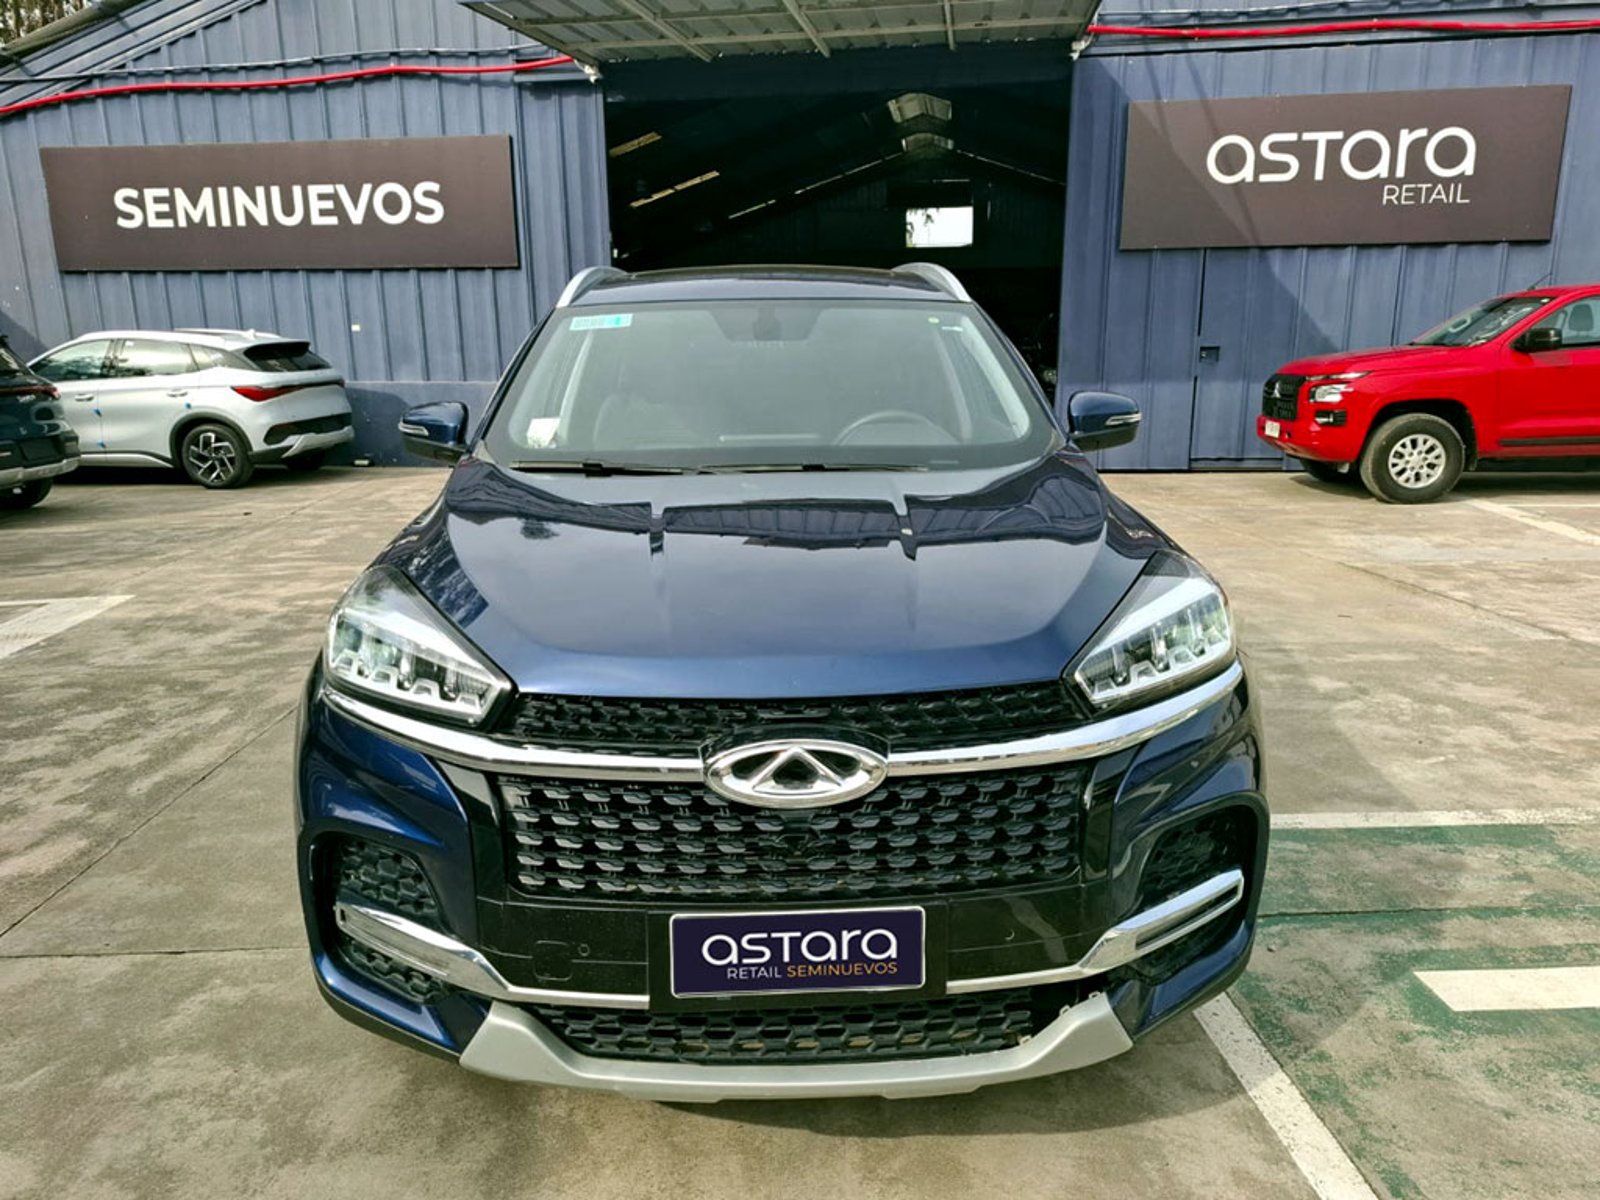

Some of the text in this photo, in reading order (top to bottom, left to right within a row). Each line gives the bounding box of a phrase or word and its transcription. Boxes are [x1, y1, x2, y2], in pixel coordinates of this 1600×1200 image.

[114, 181, 445, 229] SEMINUEVOS
[1382, 183, 1470, 205] RETAIL
[727, 962, 898, 980] RETAIL SEMINUEVOS
